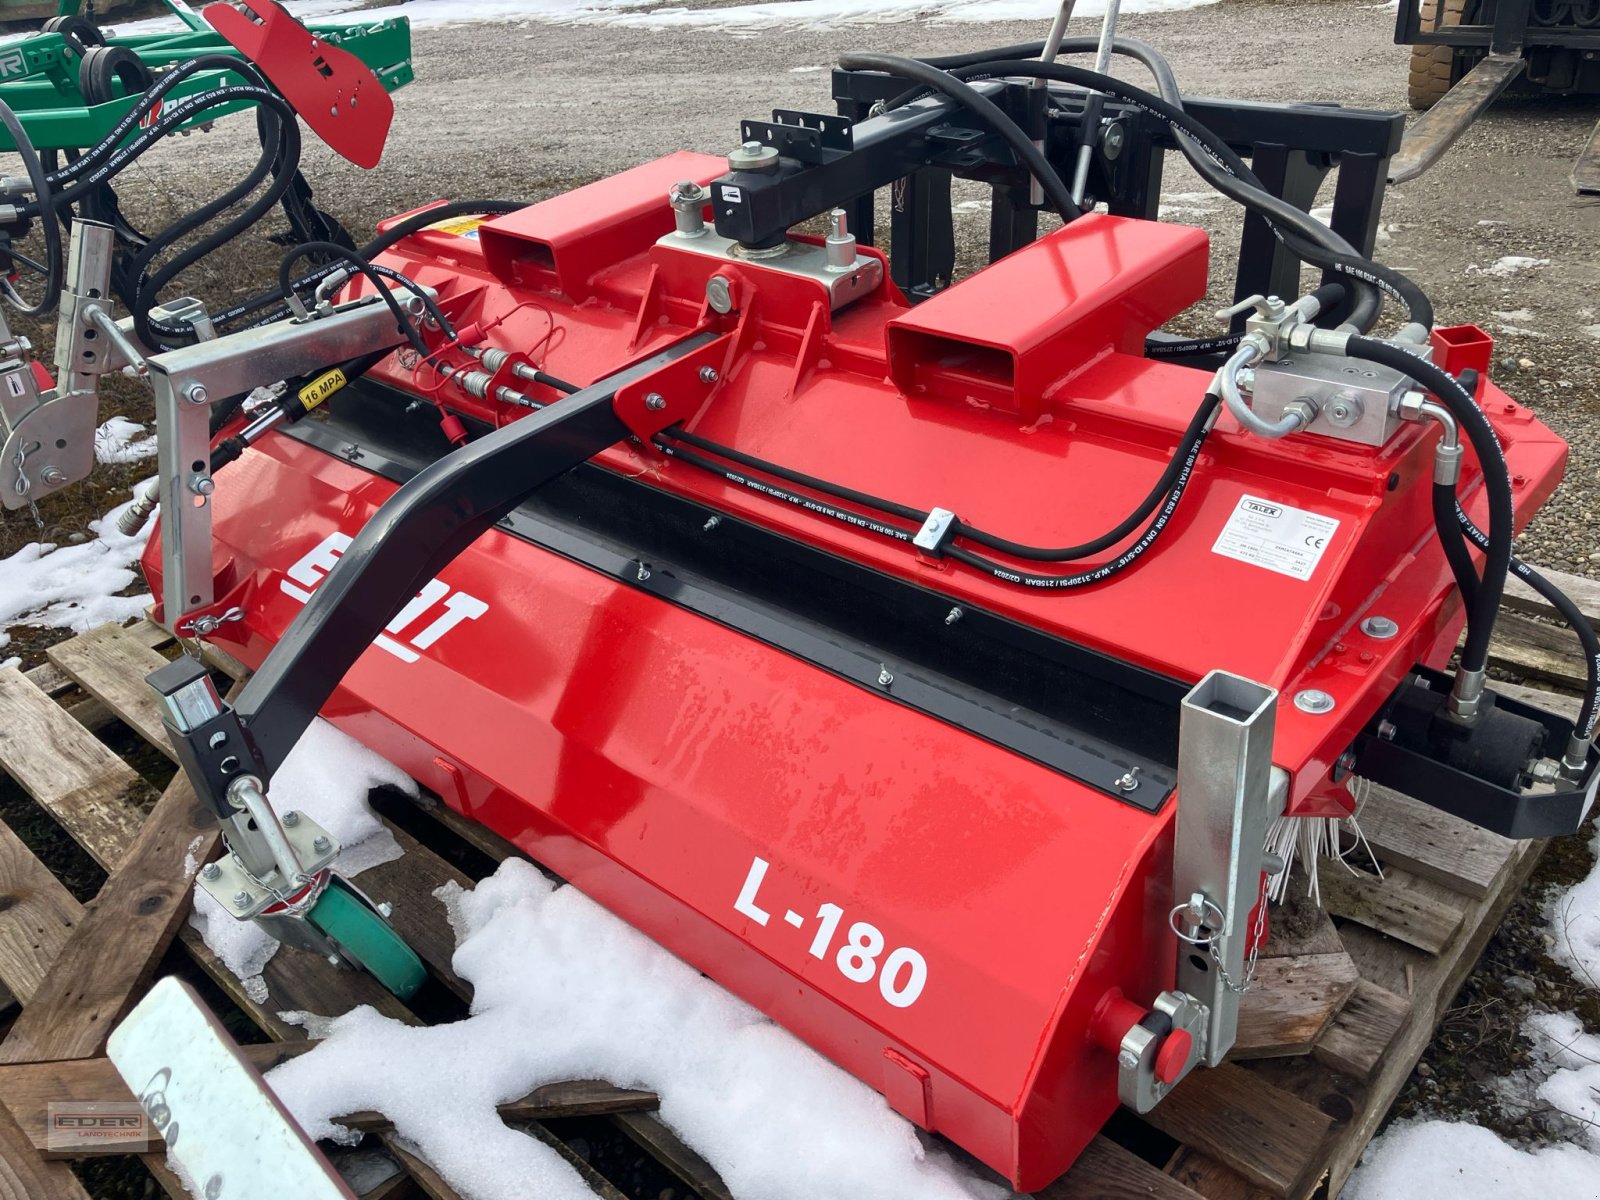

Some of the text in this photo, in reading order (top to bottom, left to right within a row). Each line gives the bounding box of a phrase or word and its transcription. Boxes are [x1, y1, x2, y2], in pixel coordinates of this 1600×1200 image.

[305, 373, 343, 404] 16 MPA
[1190, 439, 1202, 453] SAE
[1185, 454, 1195, 467] 100
[1178, 466, 1191, 487] R1AT
[1171, 490, 1181, 502] EN
[1164, 501, 1177, 515] 853
[1248, 502, 1278, 516] TALEX
[857, 519, 866, 527] EN
[1155, 514, 1168, 529] 1SN
[1457, 513, 1468, 524] EN
[895, 531, 908, 540] SAE
[1145, 530, 1158, 542] DN
[1467, 525, 1486, 543] R1AT
[993, 569, 1020, 583] Q2/2024
[1517, 564, 1531, 576] HB
[1025, 577, 1054, 587] 215BAR
[1059, 575, 1091, 587] 3120PSI
